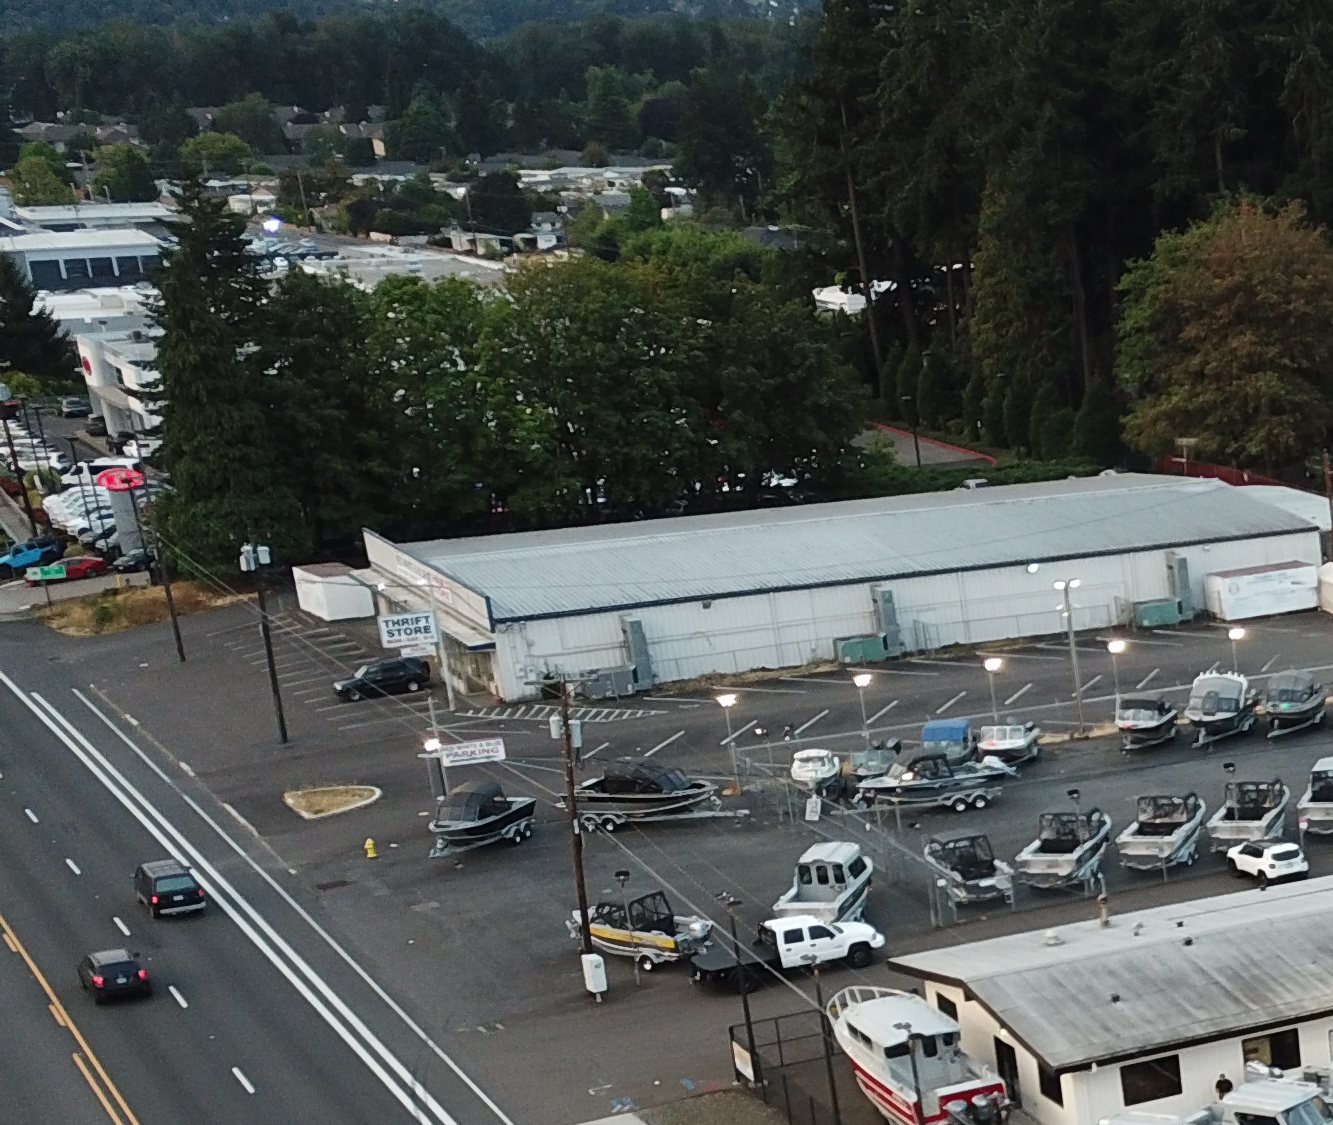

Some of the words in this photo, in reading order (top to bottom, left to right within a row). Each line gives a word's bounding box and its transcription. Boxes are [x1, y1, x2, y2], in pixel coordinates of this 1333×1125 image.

[383, 615, 431, 629] THRIFT
[386, 625, 432, 639] STORE
[445, 746, 500, 759] PARKING
